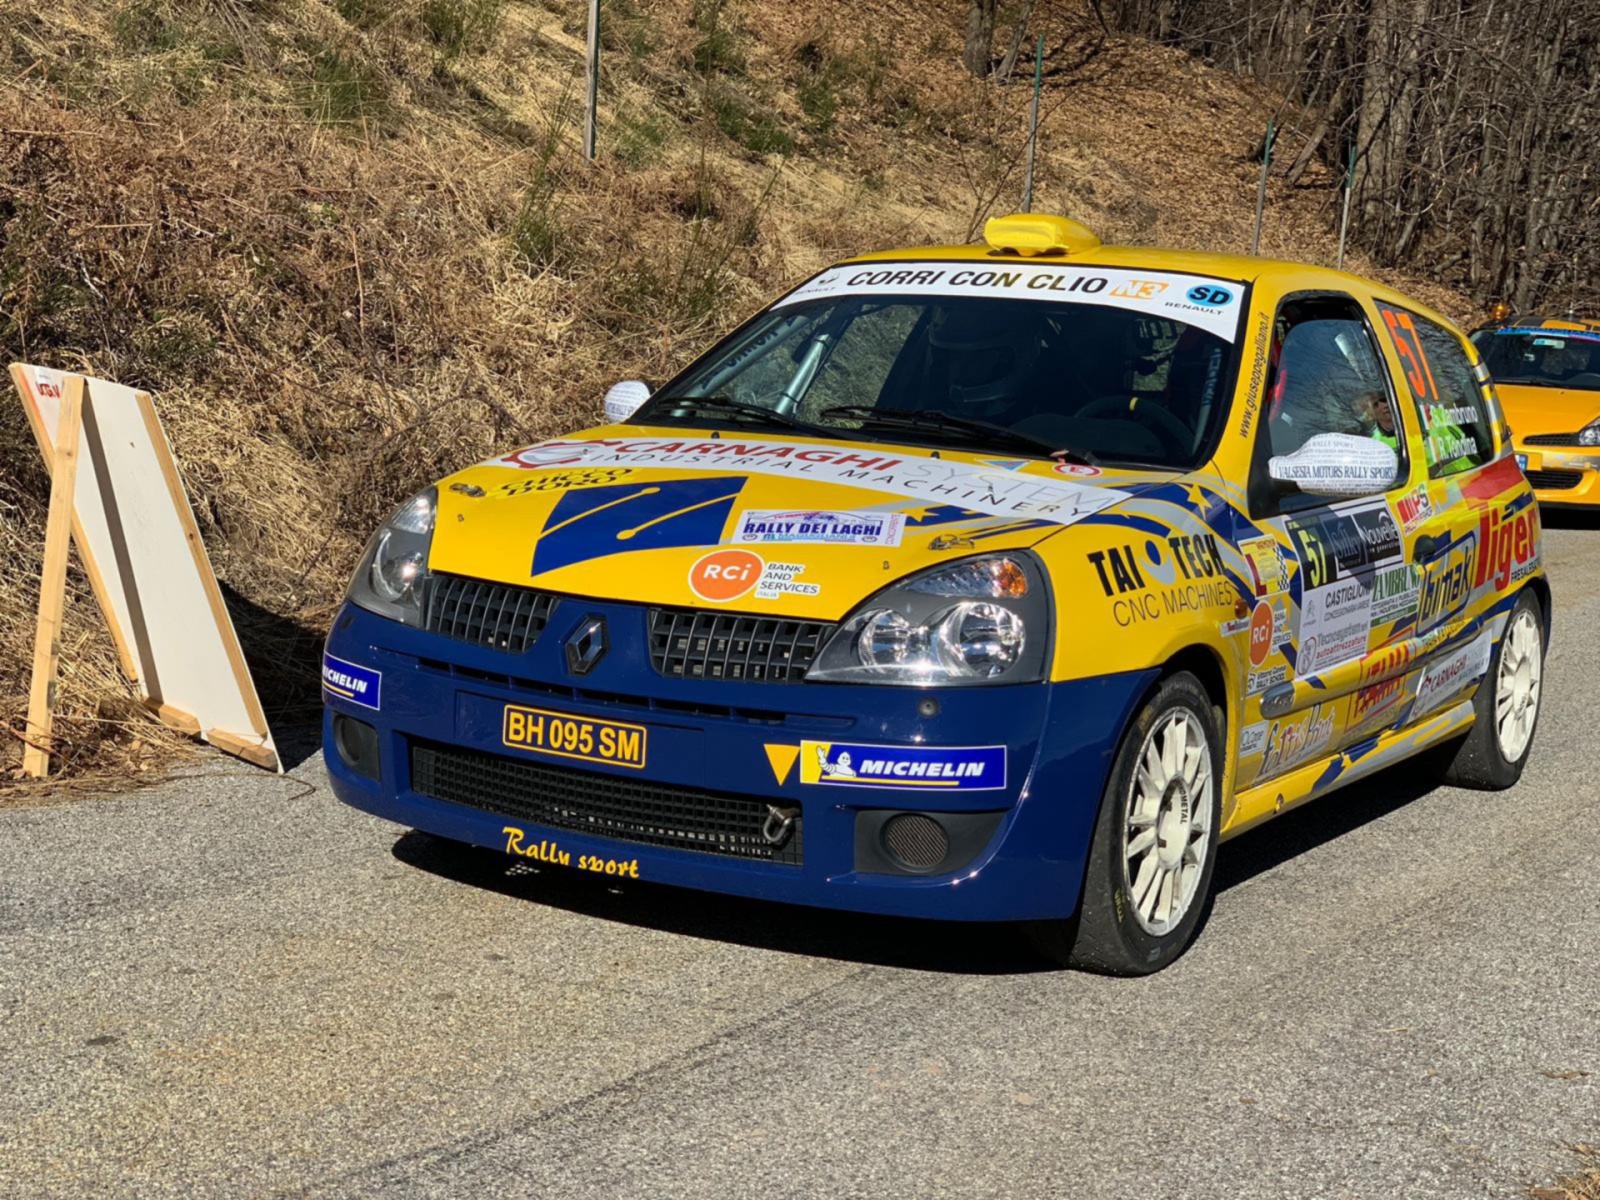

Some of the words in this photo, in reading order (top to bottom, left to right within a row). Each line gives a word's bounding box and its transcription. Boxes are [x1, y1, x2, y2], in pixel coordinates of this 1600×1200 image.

[847, 271, 939, 287] CORRI
[948, 272, 1022, 289] CON
[1027, 275, 1108, 294] CLIO
[1190, 286, 1230, 305] SD
[1164, 302, 1225, 316] RENAULT
[1382, 309, 1439, 400] 57
[611, 440, 902, 471] CARNAGHI
[904, 464, 1117, 511] SYSTEM
[1279, 465, 1312, 479] VALSESIA
[1313, 465, 1344, 479] MOTORS
[1344, 465, 1371, 479] RALLY
[1371, 466, 1394, 480] SPORT
[589, 453, 813, 473] INDUSTRIAL
[846, 468, 1090, 517] MACHINERY
[743, 523, 796, 534] RALLY
[798, 523, 827, 535] DEI
[831, 524, 882, 536] LAGHI
[1359, 521, 1399, 545] Nouvelle
[768, 563, 803, 573] BANK
[1087, 545, 1146, 597] TAI
[1168, 533, 1226, 579] TECH
[1298, 529, 1328, 587] 57
[703, 563, 754, 582] RCi
[764, 572, 792, 581] AND
[760, 581, 819, 594] SERVICES
[1113, 593, 1160, 627] CNC
[1161, 580, 1233, 615] MACHINES
[1252, 619, 1270, 645] RCi
[509, 712, 544, 745] BH
[549, 719, 593, 753] 095
[599, 727, 640, 761] SM
[859, 759, 985, 777] MICHELIN
